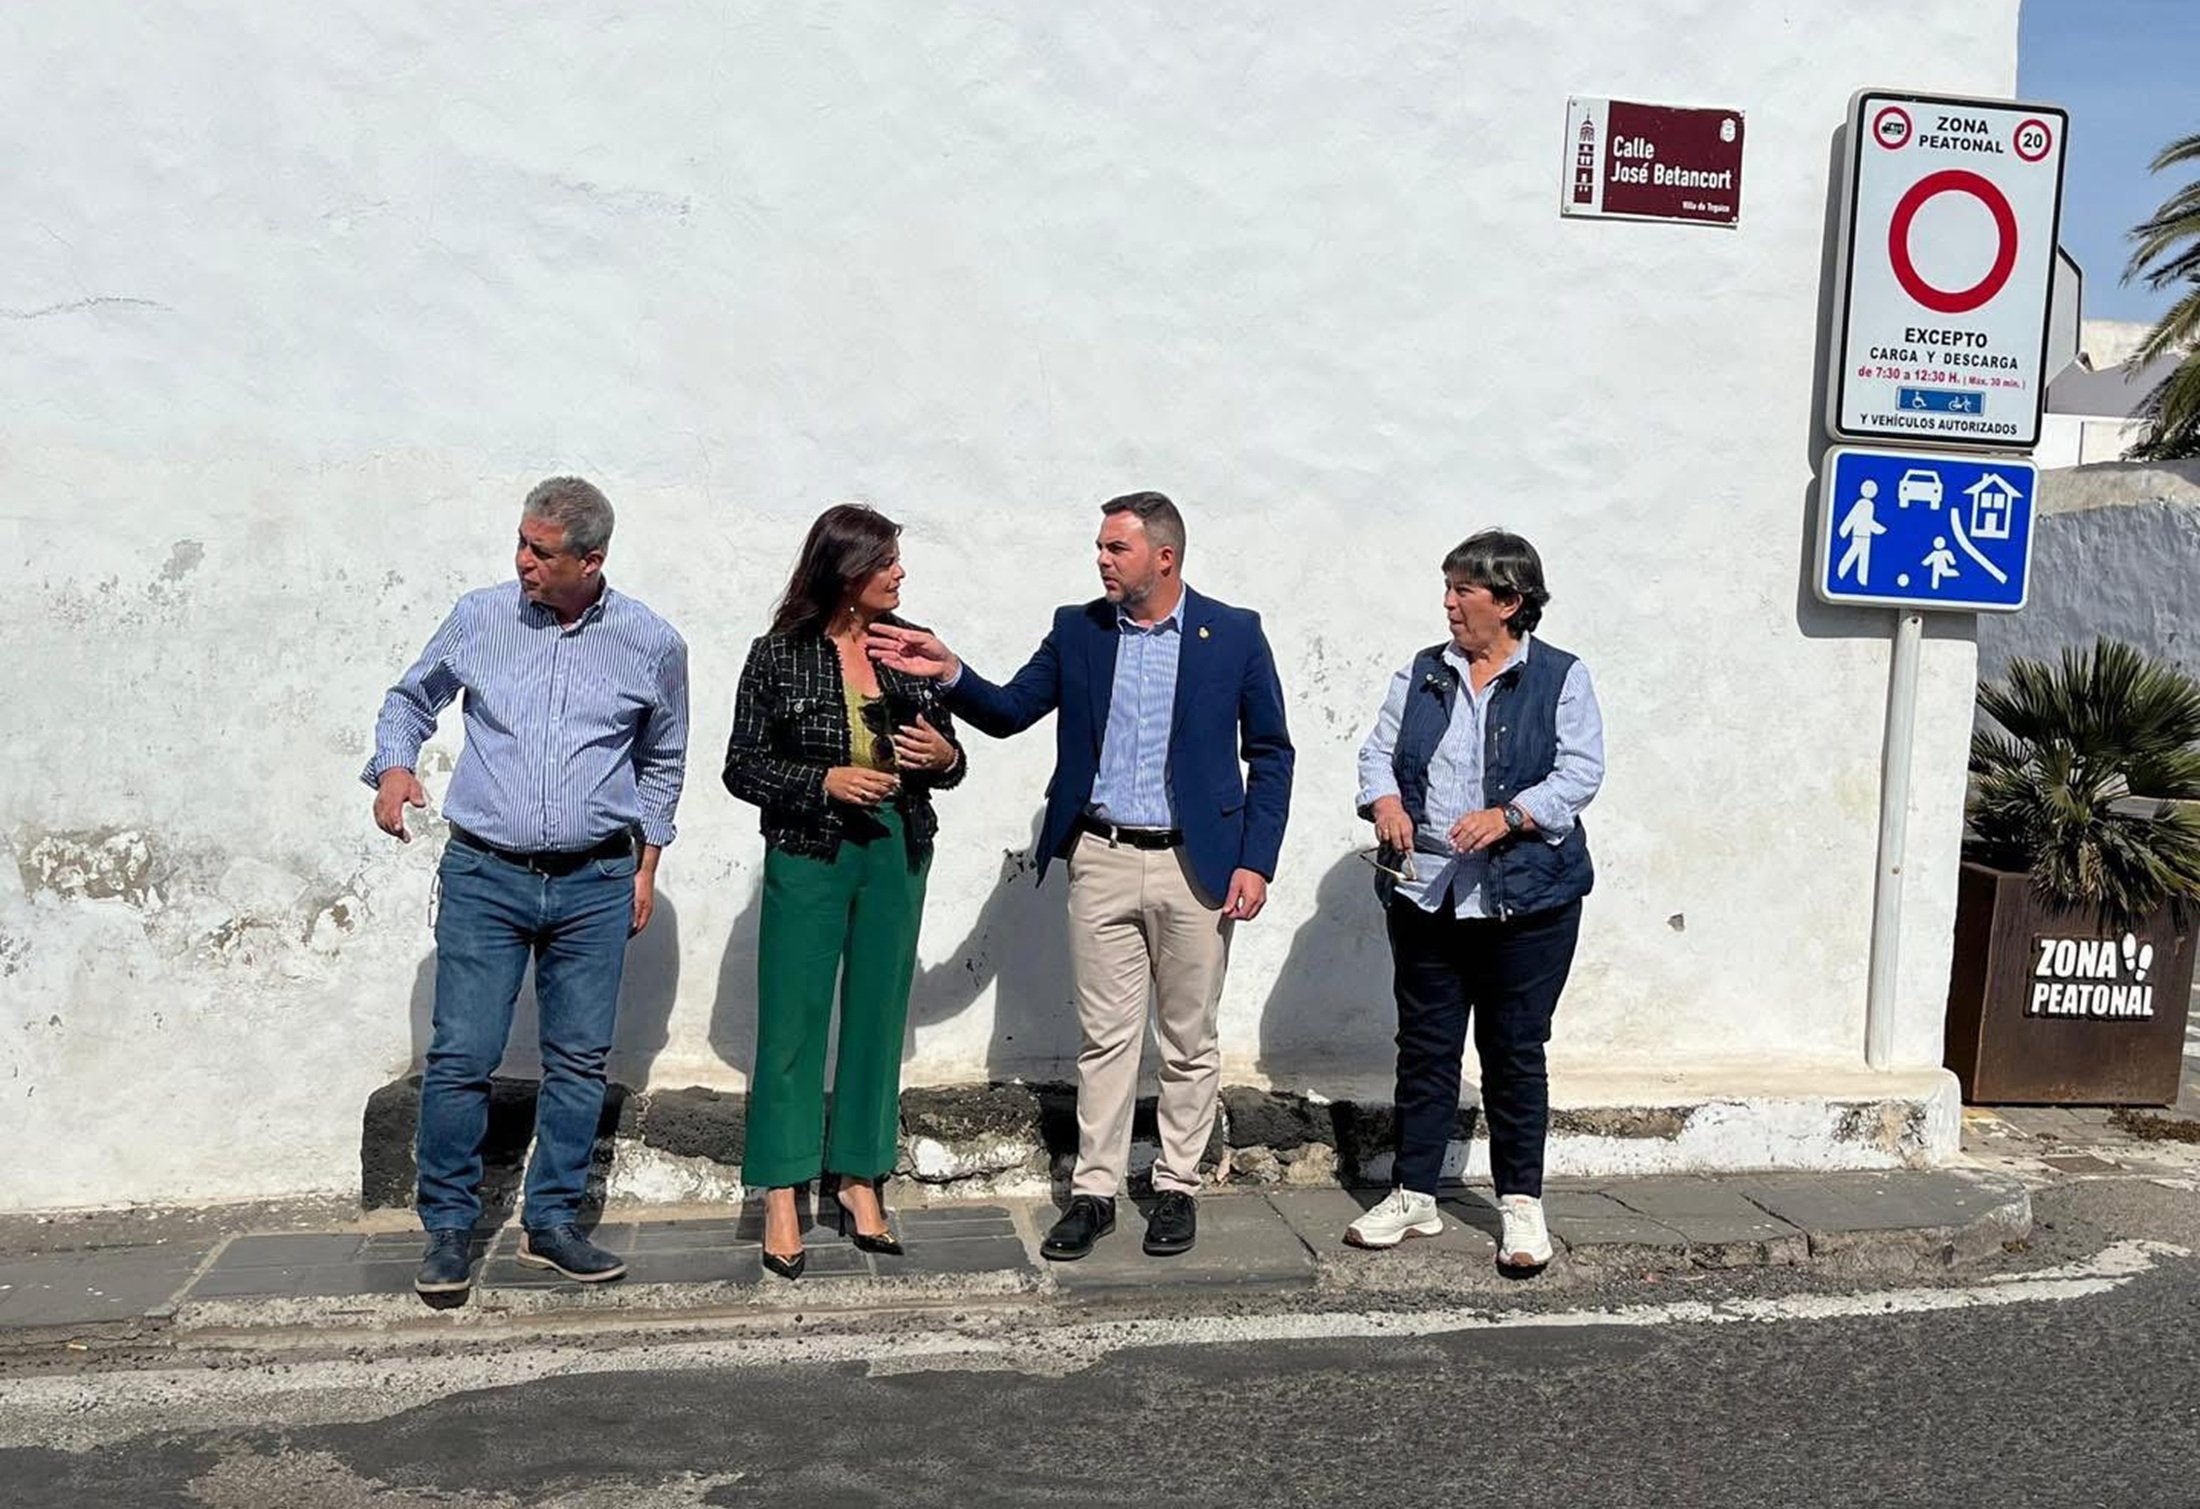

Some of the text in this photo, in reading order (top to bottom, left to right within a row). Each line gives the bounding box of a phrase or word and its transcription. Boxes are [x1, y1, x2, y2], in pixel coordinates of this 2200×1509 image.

[1937, 116, 1989, 134] ZONA
[1613, 136, 1655, 159] Calle
[1918, 135, 2004, 153] PEATONAL
[2023, 133, 2043, 148] 20
[1610, 161, 1732, 189] José Betancort
[1904, 327, 1988, 348] EXCEPTO
[1870, 347, 2018, 370] CARGA Y DESCARGA
[1858, 366, 1872, 378] de
[1876, 367, 1900, 380] 7:30
[1903, 370, 1911, 380] a
[1915, 369, 1945, 382] 12:30
[1860, 413, 2017, 435] Y VEHÍCULOS AUTORIZADOS
[2035, 939, 2118, 979] ZONA
[2030, 983, 2154, 1017] PEATONAL
